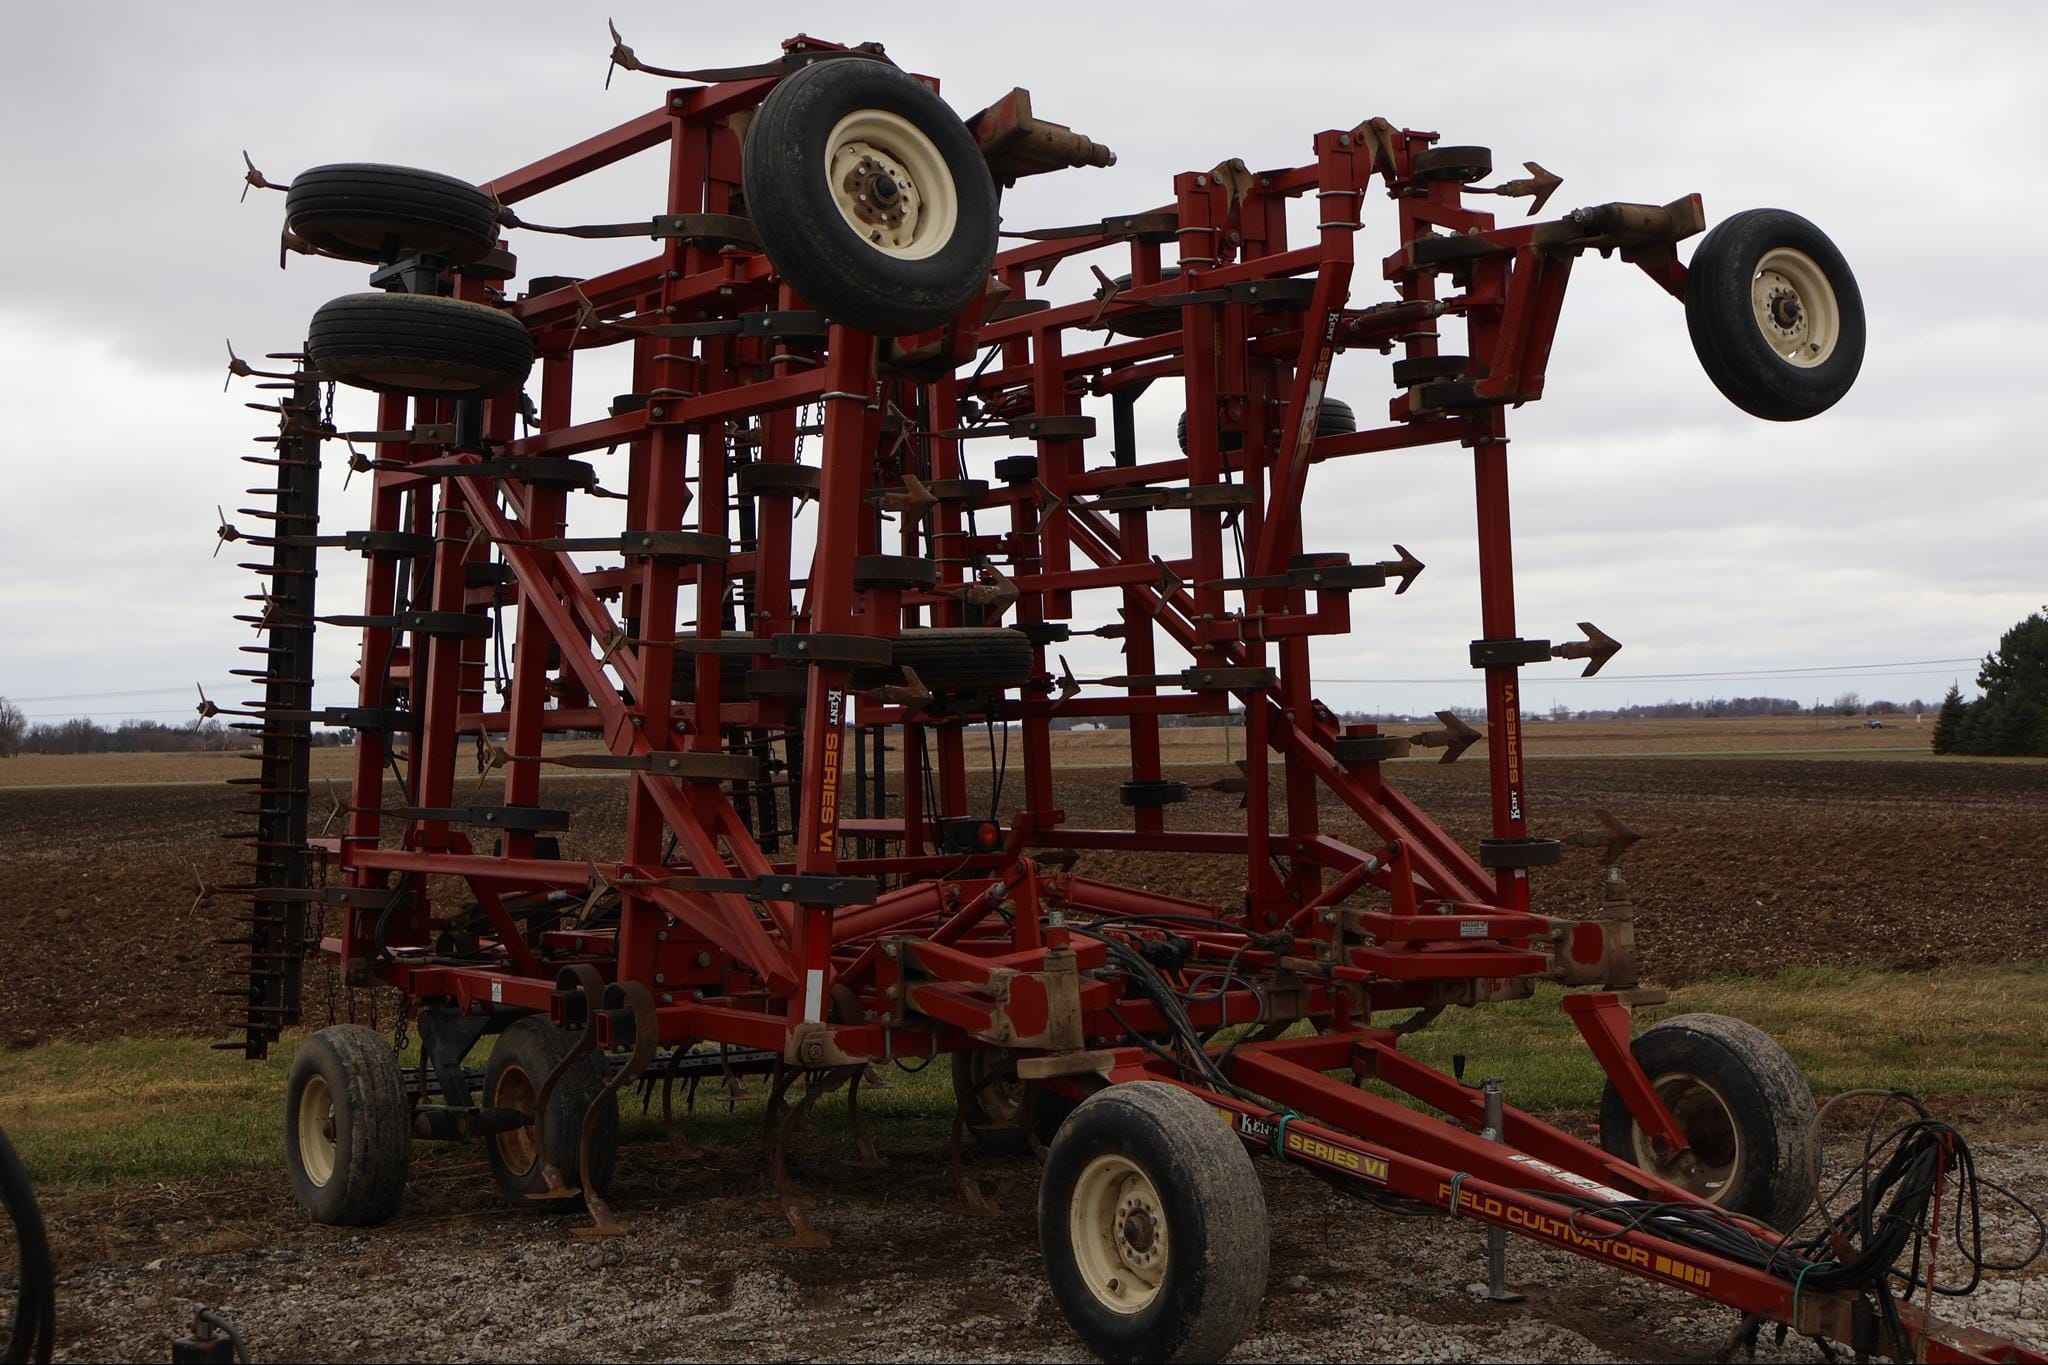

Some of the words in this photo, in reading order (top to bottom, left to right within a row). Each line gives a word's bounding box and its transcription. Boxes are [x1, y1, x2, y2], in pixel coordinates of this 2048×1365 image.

[828, 689, 842, 725] KENT
[1505, 684, 1514, 703] VI
[1506, 708, 1519, 784] SERIES
[821, 732, 838, 824] SERIES
[819, 830, 833, 852] VI
[1289, 1133, 1359, 1168] SERIES
[1364, 1159, 1387, 1177] VI
[1438, 1183, 1502, 1217] FELD
[1506, 1206, 1650, 1267] CULTIVATOR
